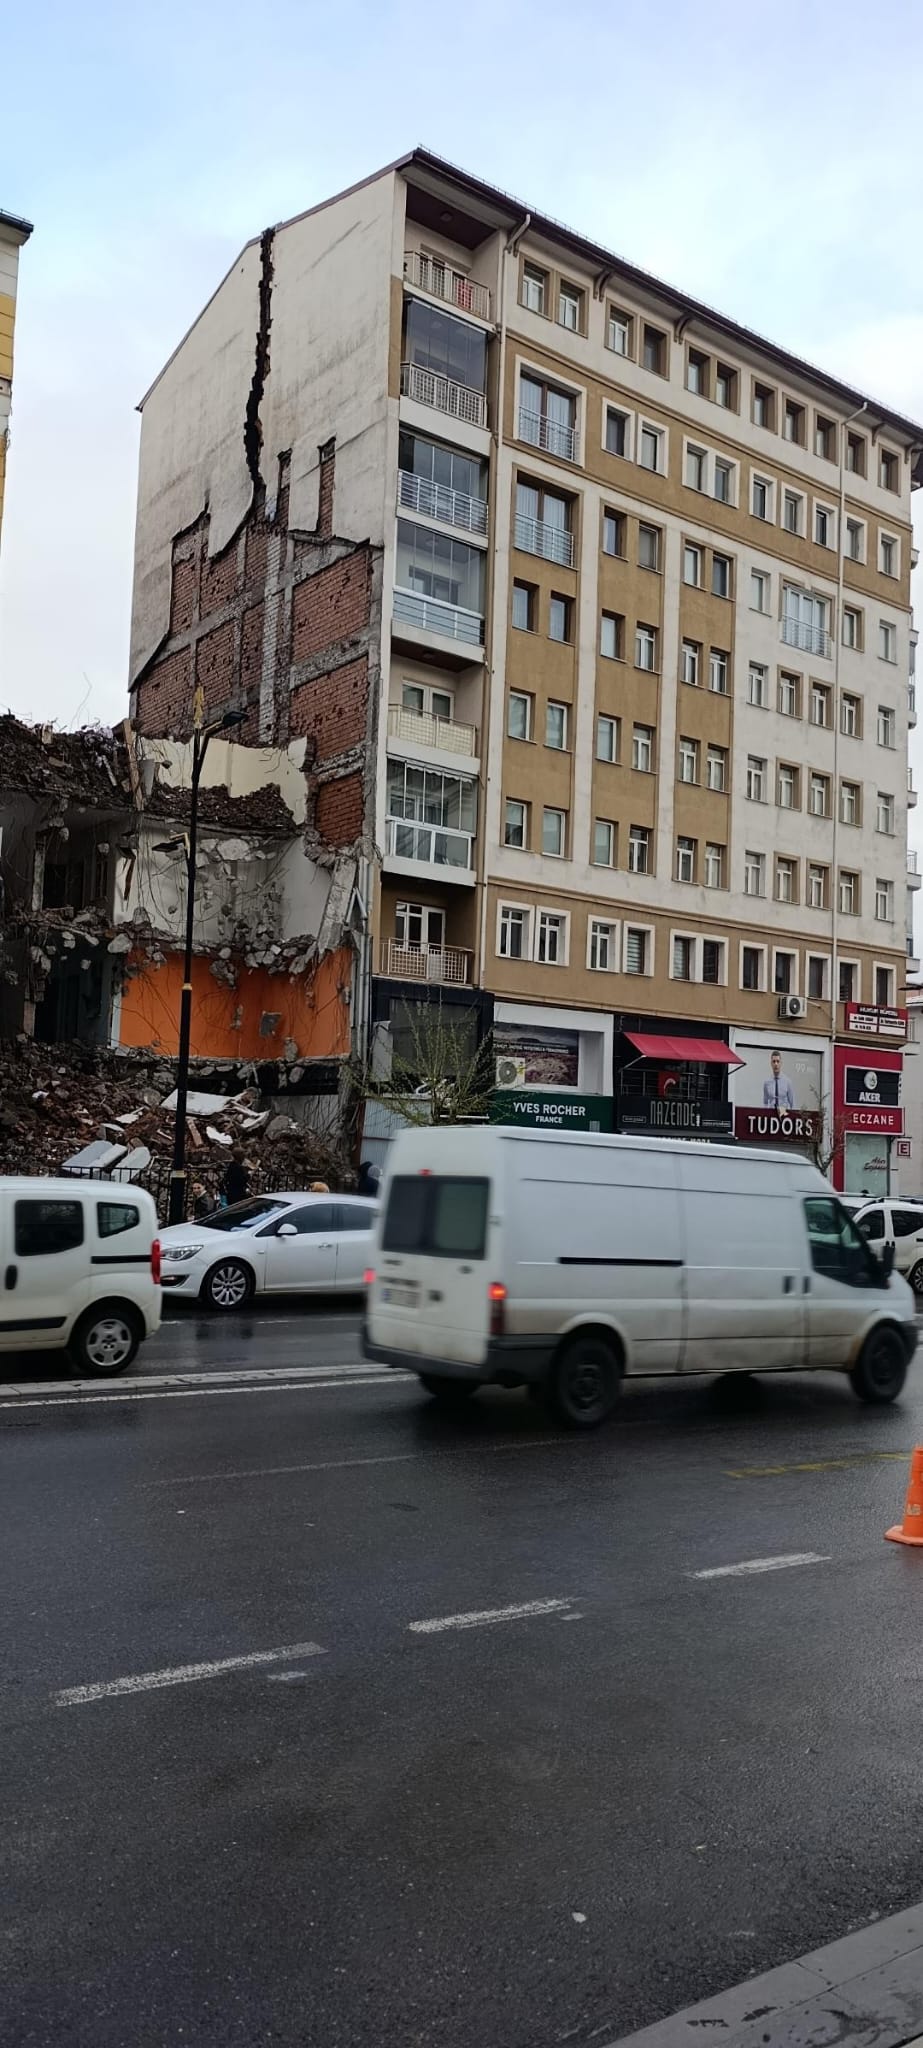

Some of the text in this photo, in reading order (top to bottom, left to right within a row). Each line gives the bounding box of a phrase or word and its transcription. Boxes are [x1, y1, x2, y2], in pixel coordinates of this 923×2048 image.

[859, 1091, 881, 1103] AKER
[513, 1102, 586, 1116] YVES ROCHER
[535, 1115, 563, 1124] FRANCE
[853, 1113, 894, 1126] ECZANE
[748, 1116, 813, 1137] TUDORS
[900, 1143, 909, 1155] E
